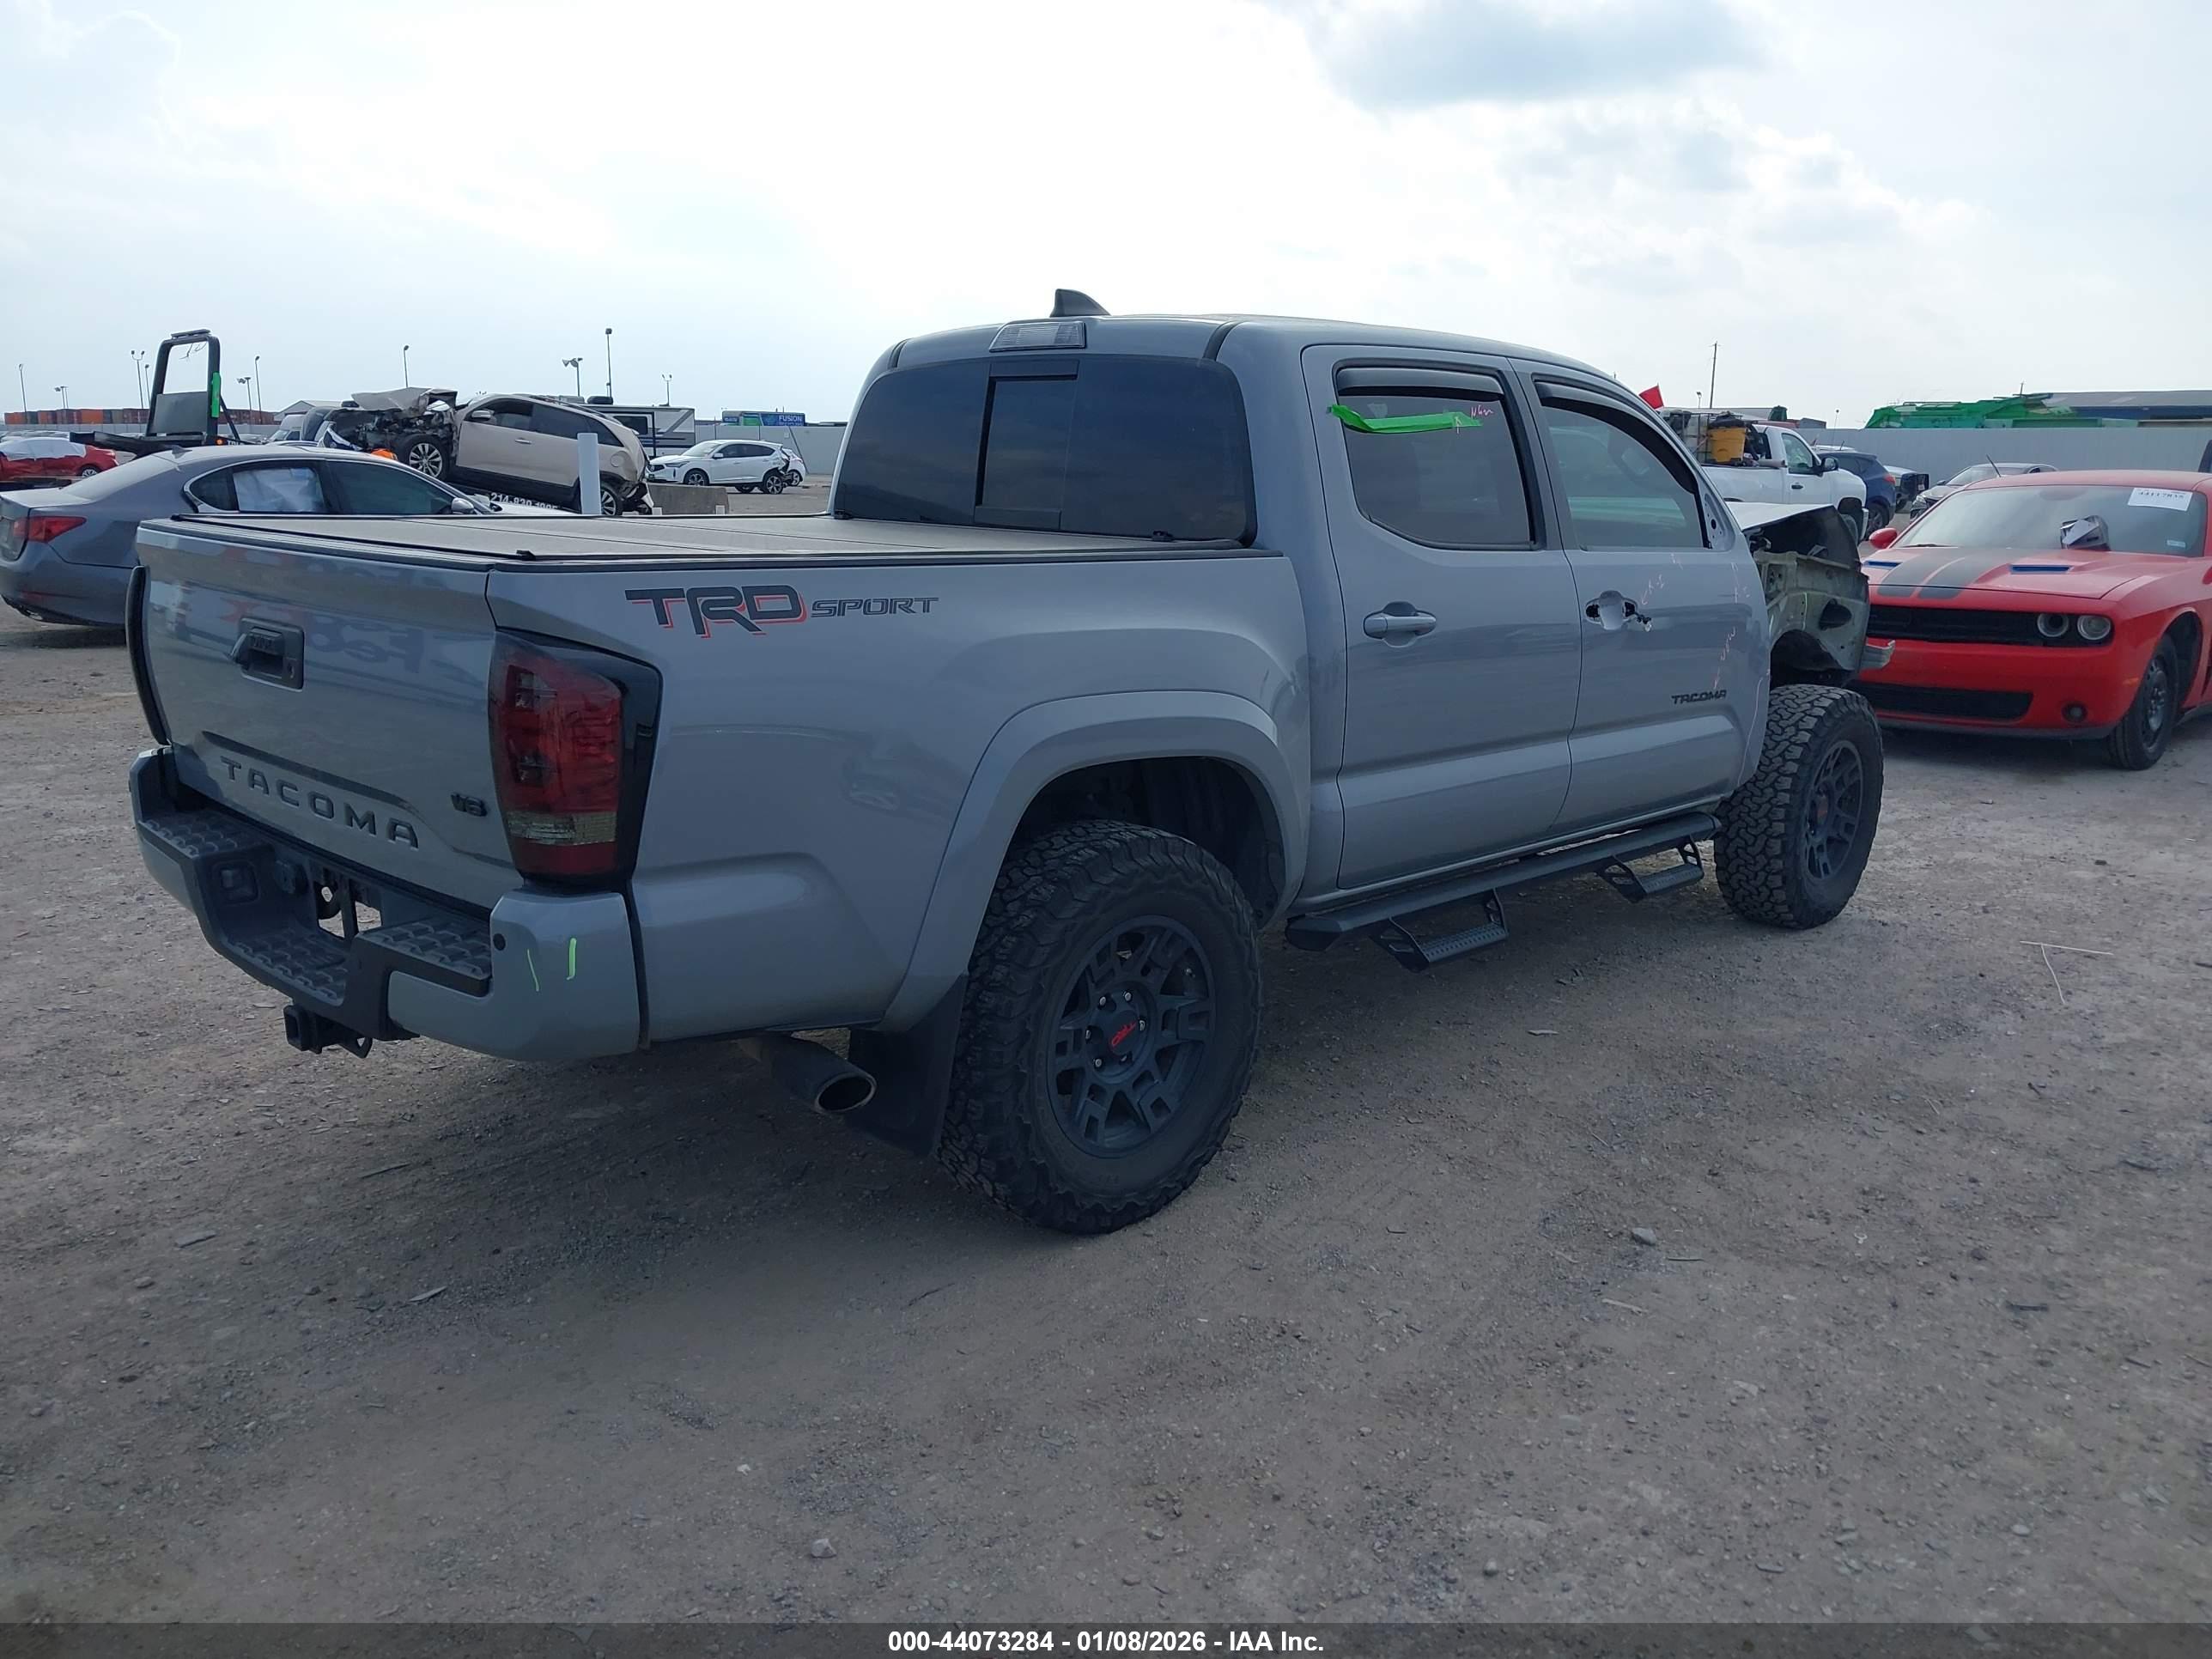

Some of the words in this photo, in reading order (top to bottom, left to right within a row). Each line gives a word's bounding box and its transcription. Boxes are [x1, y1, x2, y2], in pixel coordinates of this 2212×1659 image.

[624, 585, 807, 639] TRD
[811, 598, 939, 618] SPORT
[1671, 690, 1728, 705] TACOMA
[220, 756, 419, 851] TACOMA
[450, 792, 488, 817] V6
